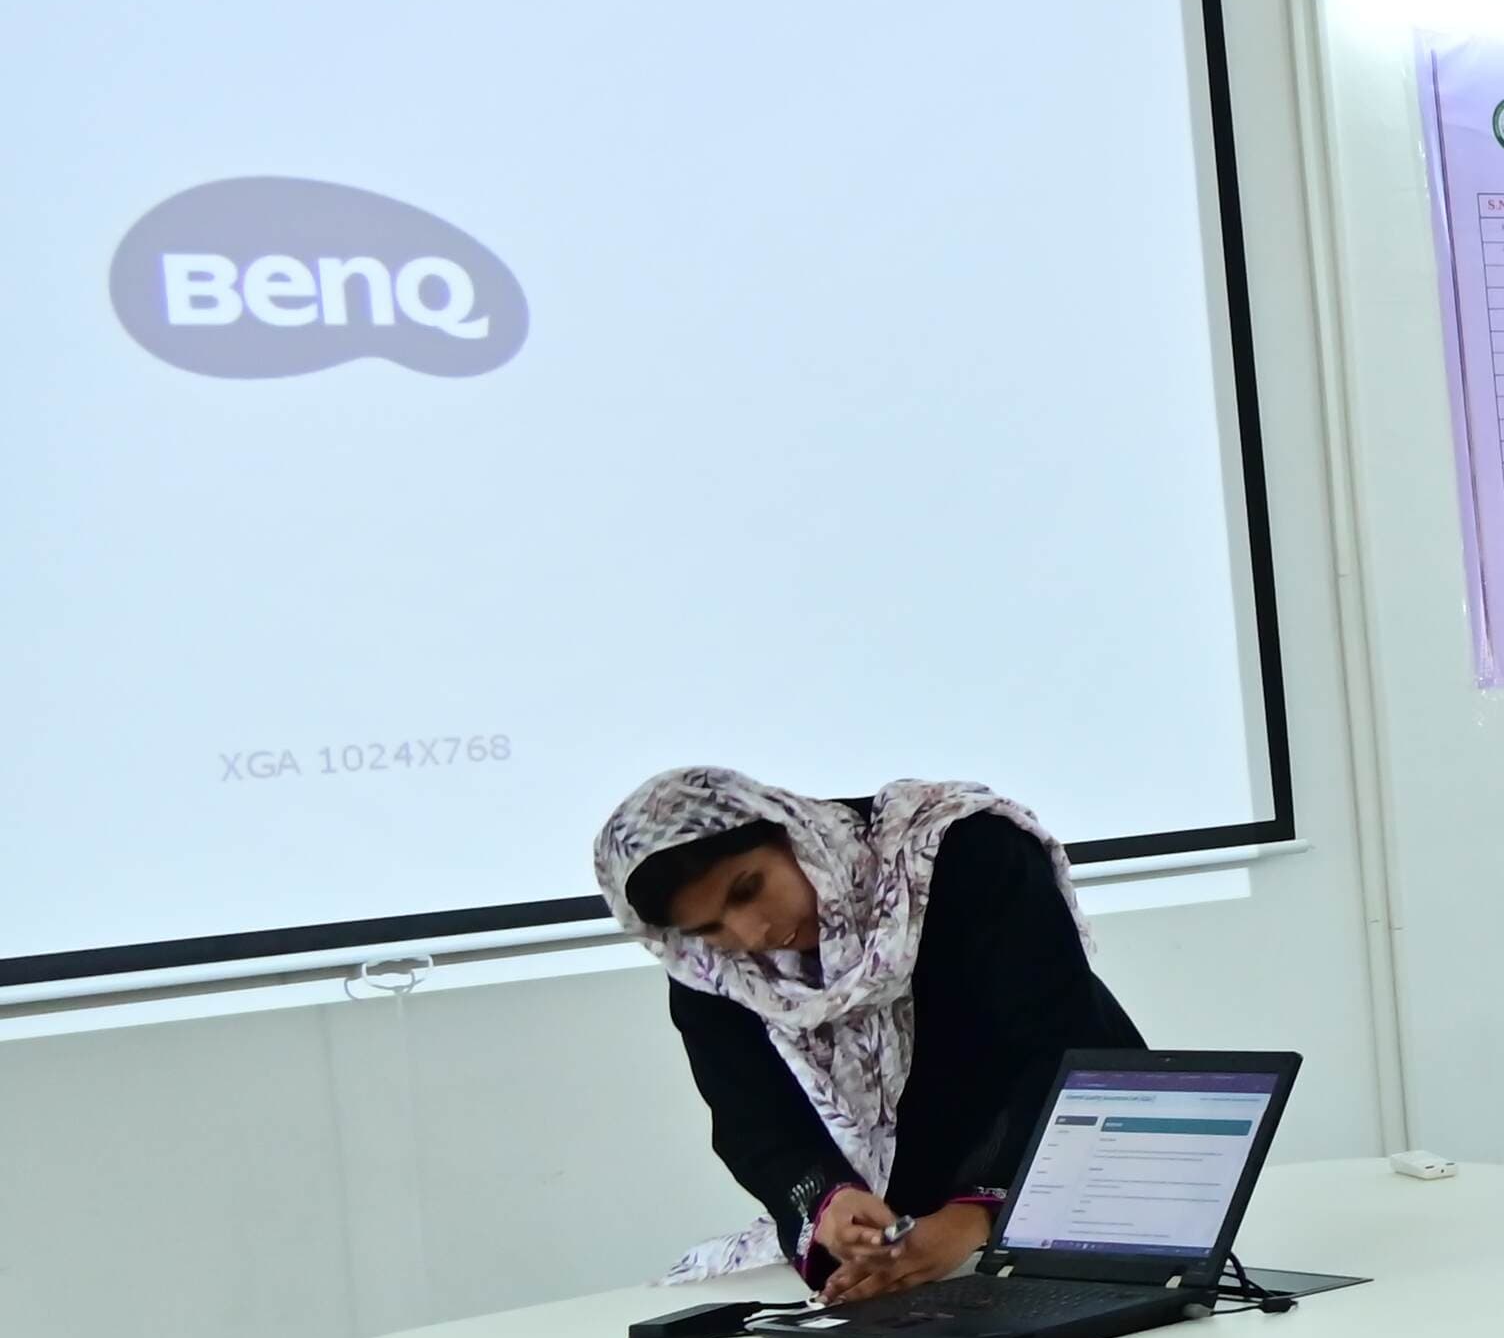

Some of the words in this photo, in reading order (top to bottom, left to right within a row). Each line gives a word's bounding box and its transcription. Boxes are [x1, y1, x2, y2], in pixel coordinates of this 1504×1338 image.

[162, 253, 489, 339] BenQ
[219, 751, 302, 783] XGA
[319, 733, 513, 776] 1024X768
